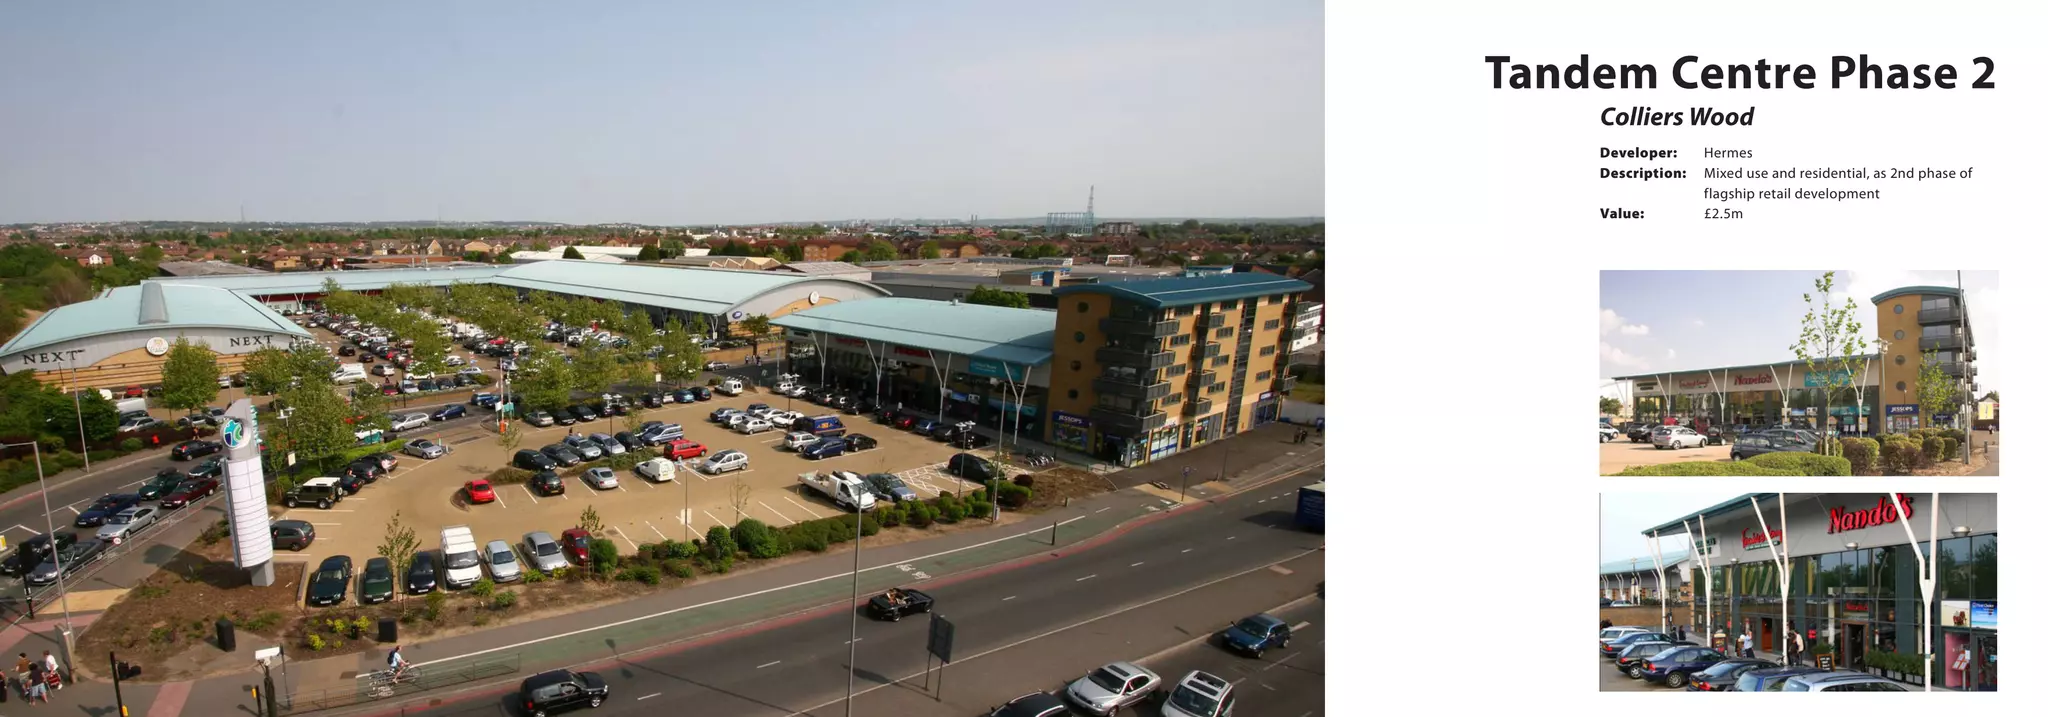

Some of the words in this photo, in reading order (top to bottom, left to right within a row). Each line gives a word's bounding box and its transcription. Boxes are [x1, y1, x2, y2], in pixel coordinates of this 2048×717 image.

[229, 334, 273, 347] NEXT
[23, 350, 78, 365] NEXT
[1828, 493, 1913, 533] Nando's
